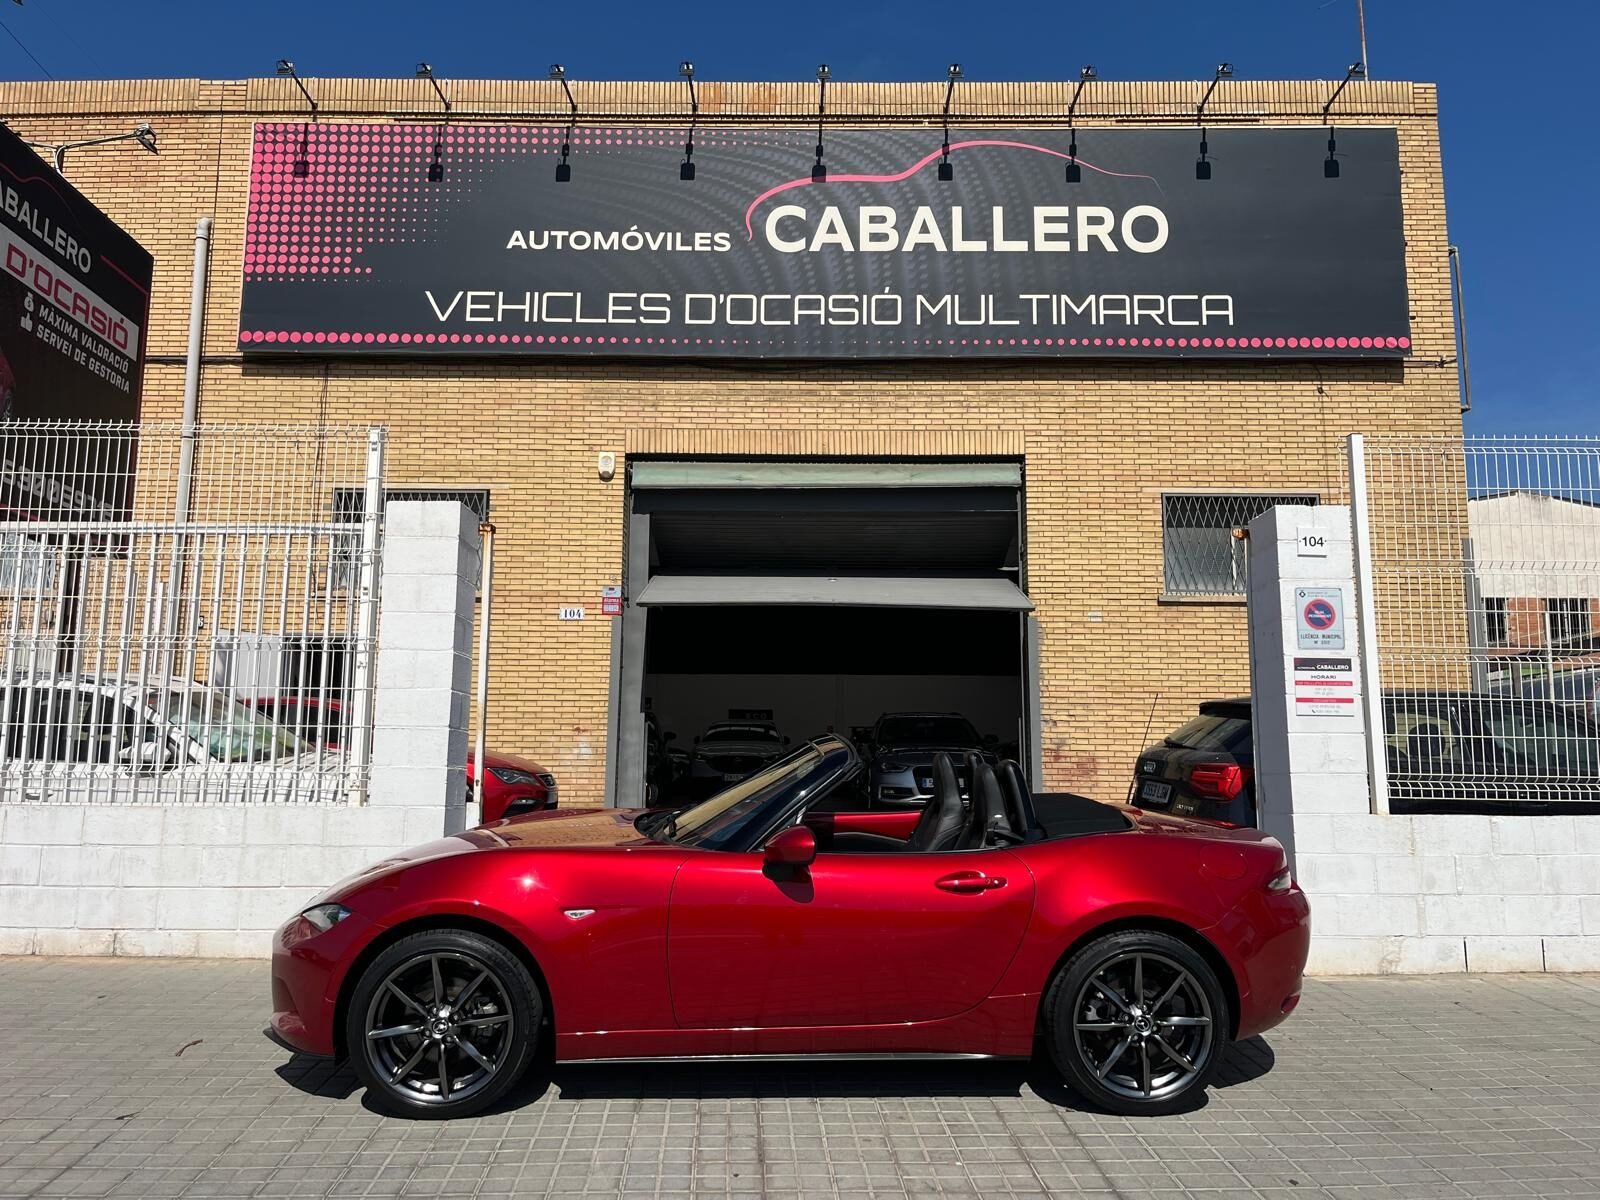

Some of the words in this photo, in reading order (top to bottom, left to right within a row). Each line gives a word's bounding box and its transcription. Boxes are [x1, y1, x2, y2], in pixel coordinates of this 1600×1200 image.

[0, 179, 92, 274] BALLERO
[507, 225, 732, 252] AUTOMÓVILES
[765, 205, 1169, 254] CABALLERO
[6, 242, 129, 350] D'OCASIÓ
[424, 290, 671, 325] VEHICLES
[684, 286, 902, 326] D'OCASIÓ
[916, 293, 1234, 326] MULTIMARCA
[36, 325, 72, 358] SERVEI
[73, 348, 87, 366] DE
[88, 357, 131, 393] GESTORIA
[39, 304, 79, 342] MÀXIMA
[80, 332, 129, 374] VALORACIÓ
[1302, 536, 1324, 547] 104
[564, 609, 581, 618] 104
